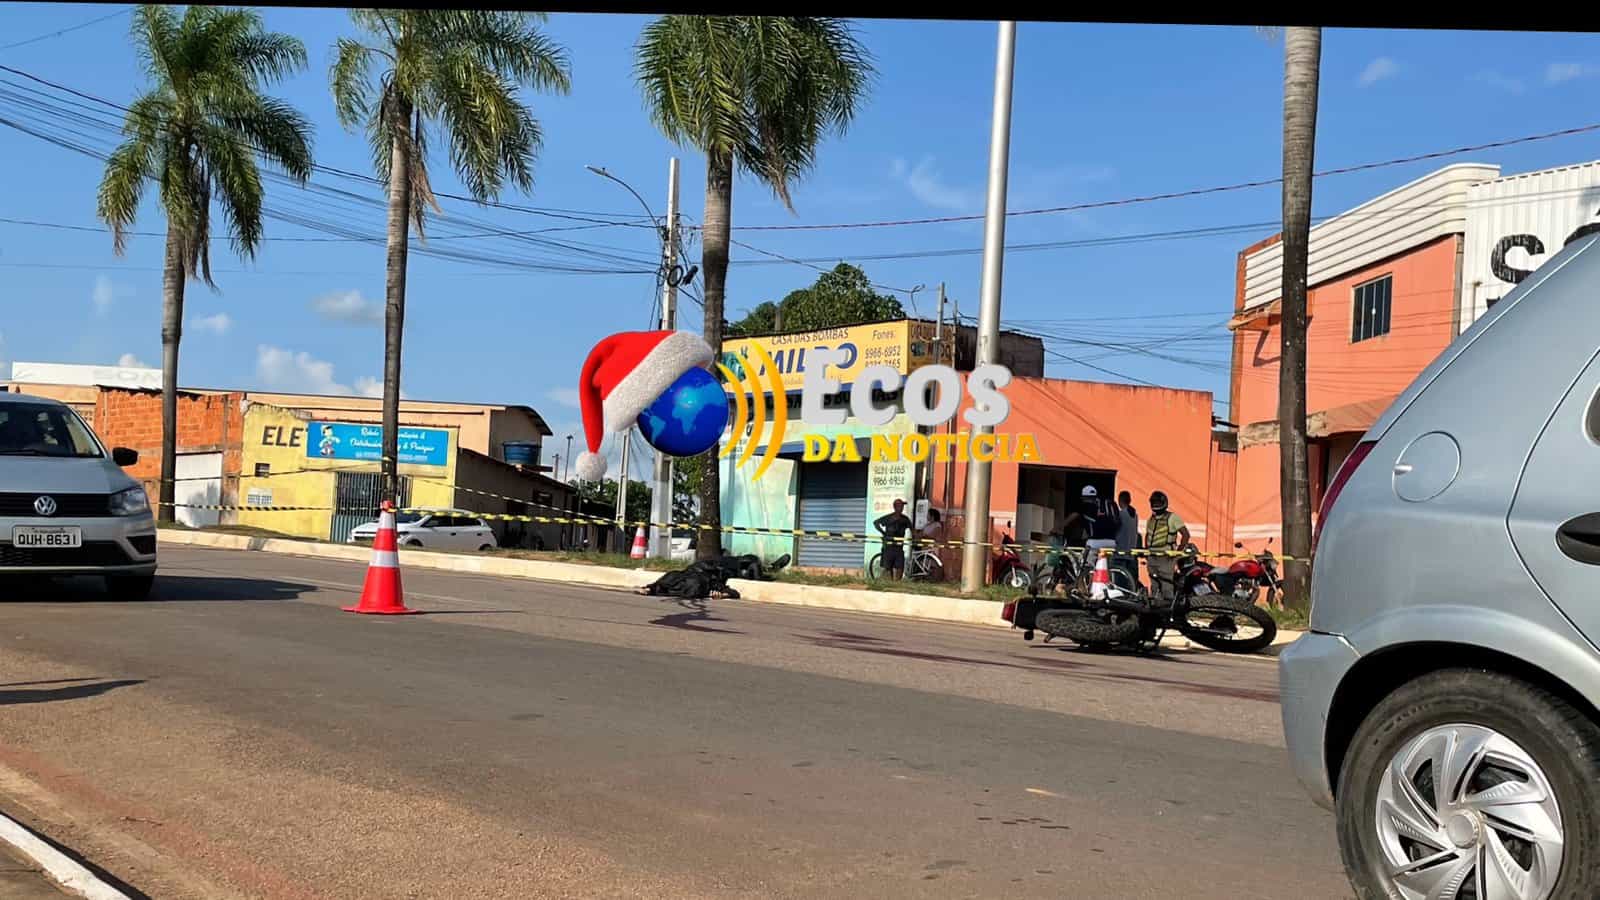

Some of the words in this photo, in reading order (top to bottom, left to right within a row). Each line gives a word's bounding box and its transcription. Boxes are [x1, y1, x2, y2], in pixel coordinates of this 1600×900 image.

[771, 334, 793, 346] CASA
[794, 332, 811, 344] DAS
[812, 328, 849, 342] BOMBAS
